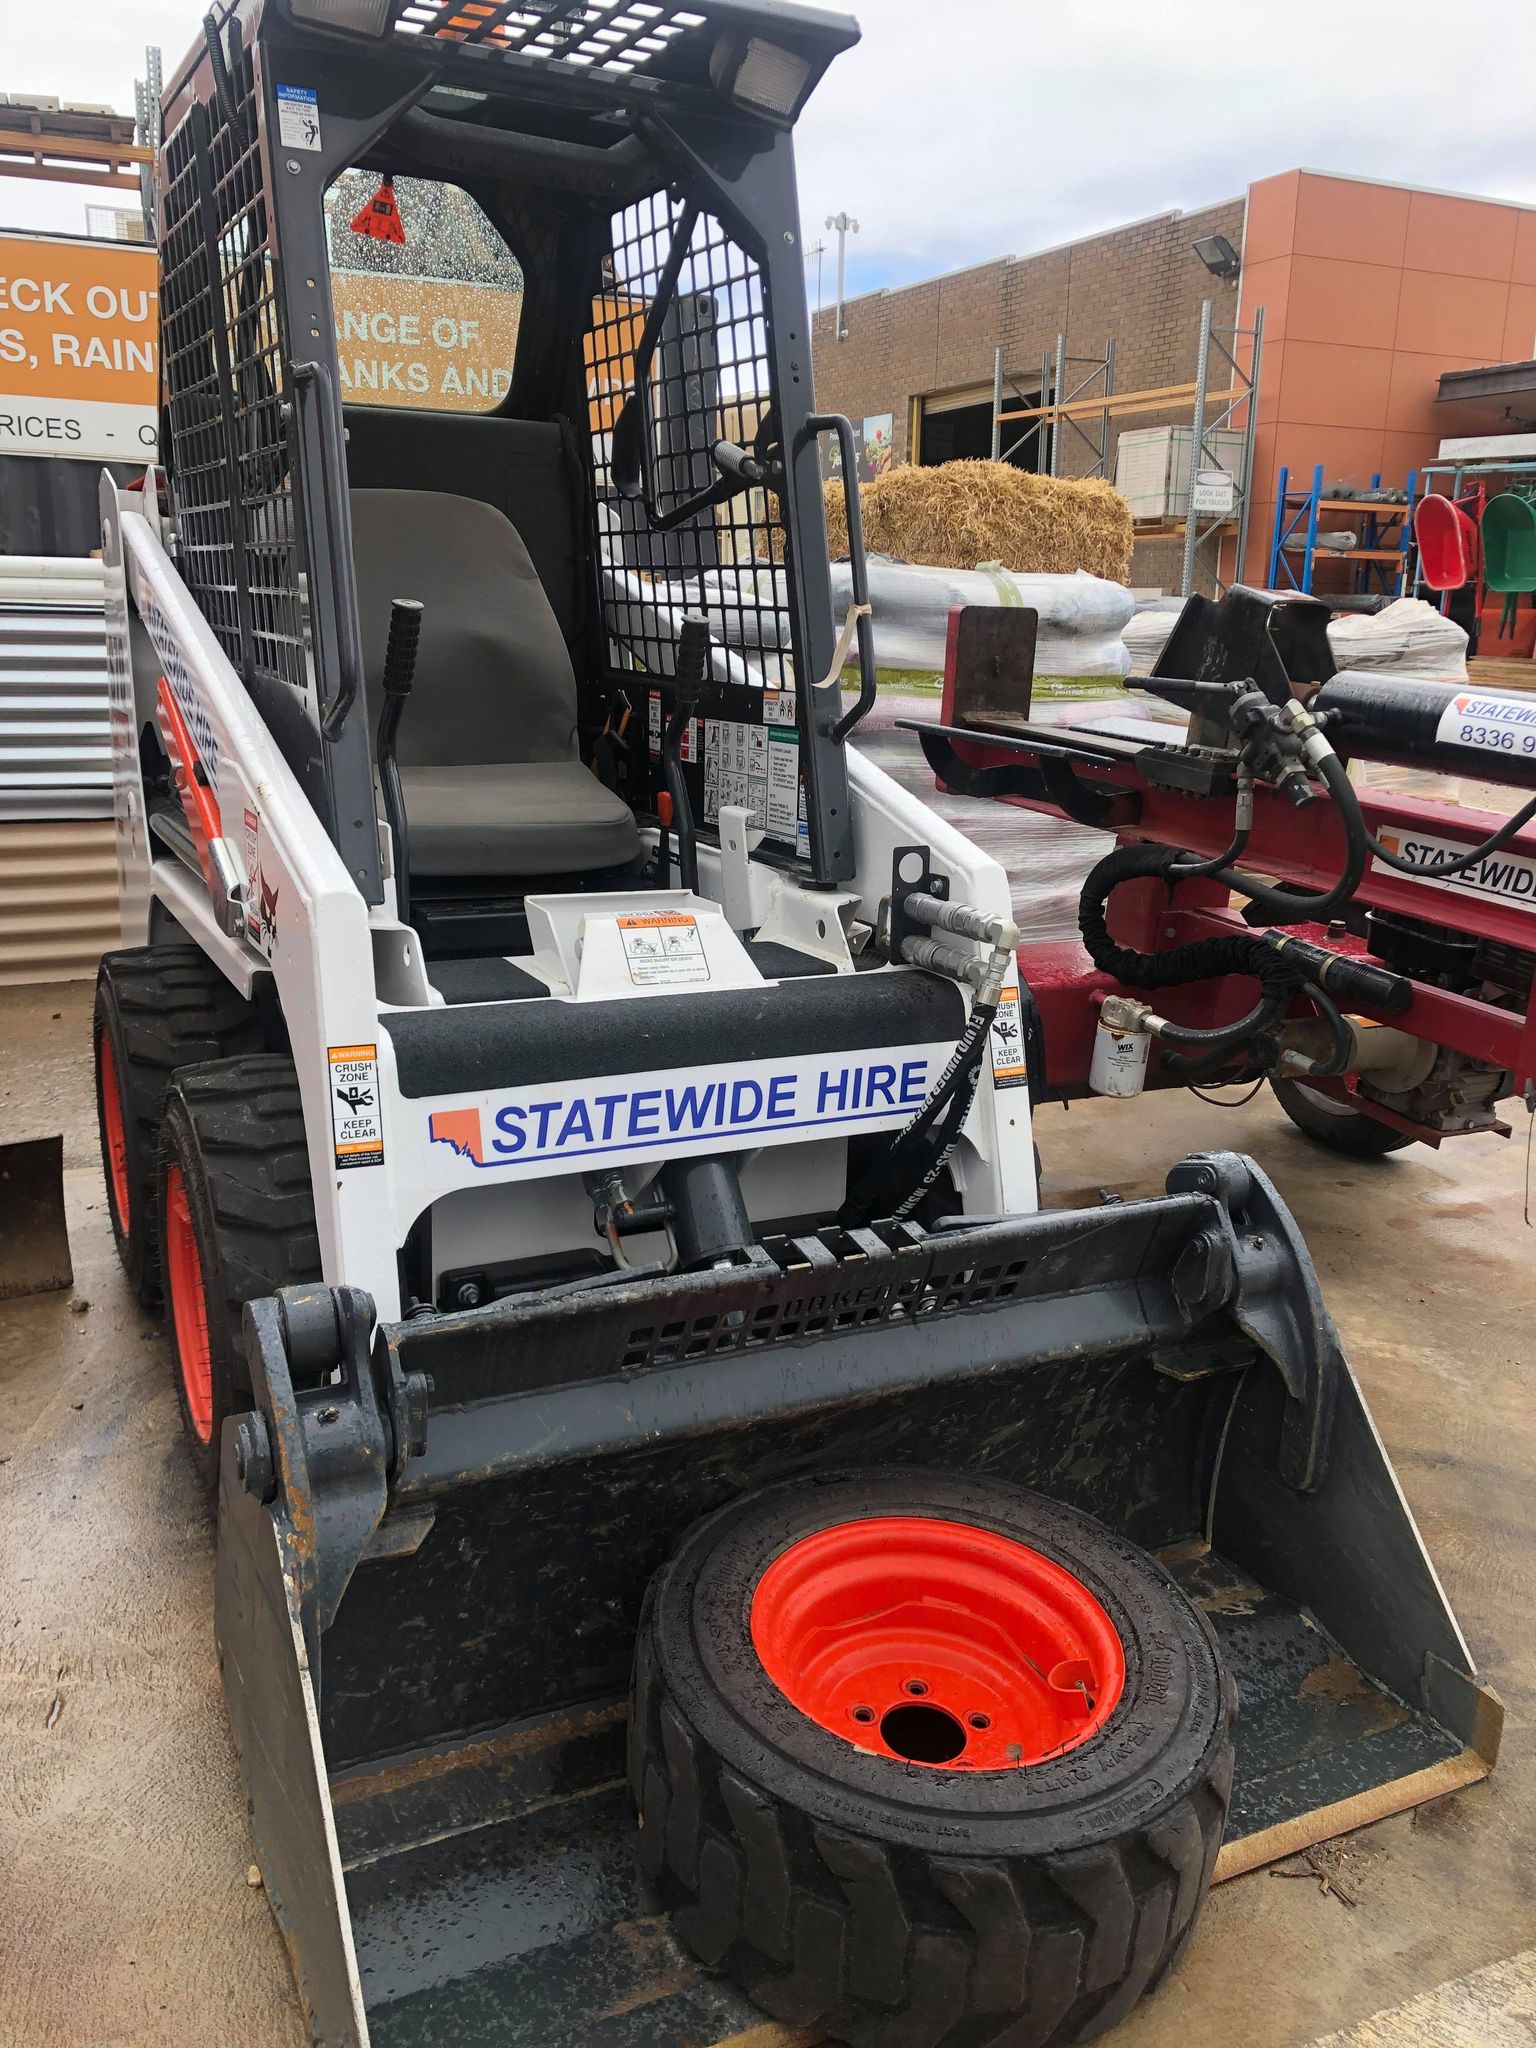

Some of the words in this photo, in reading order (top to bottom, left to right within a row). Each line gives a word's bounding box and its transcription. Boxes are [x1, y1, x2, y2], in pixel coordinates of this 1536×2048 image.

[286, 87, 308, 95] SAFETY
[278, 92, 316, 103] INFORMATION
[431, 317, 481, 349] OF
[52, 333, 158, 373] RAIN
[441, 367, 513, 398] AND
[1199, 489, 1214, 497] LOOK
[1215, 490, 1227, 498] OUT
[1460, 725, 1515, 750] 8336
[1401, 842, 1536, 897] STATEWID
[641, 917, 688, 925] WARNING
[996, 1002, 1016, 1010] RUSH
[955, 1014, 985, 1053] FLUID
[998, 1048, 1018, 1057] KEEP
[1117, 1043, 1134, 1051] WIX
[337, 1050, 374, 1058] WARNING
[996, 1056, 1020, 1065] CLEAR
[335, 1063, 372, 1073] CRUSH
[340, 1072, 369, 1083] ZONE
[492, 1074, 798, 1153] STATEWIDE
[817, 1060, 928, 1113] HIRE
[344, 1119, 372, 1129] KEEP
[340, 1129, 376, 1140] CLEAR
[895, 1187, 929, 1221] MSHA
[1020, 1765, 1095, 1797] DUTY
